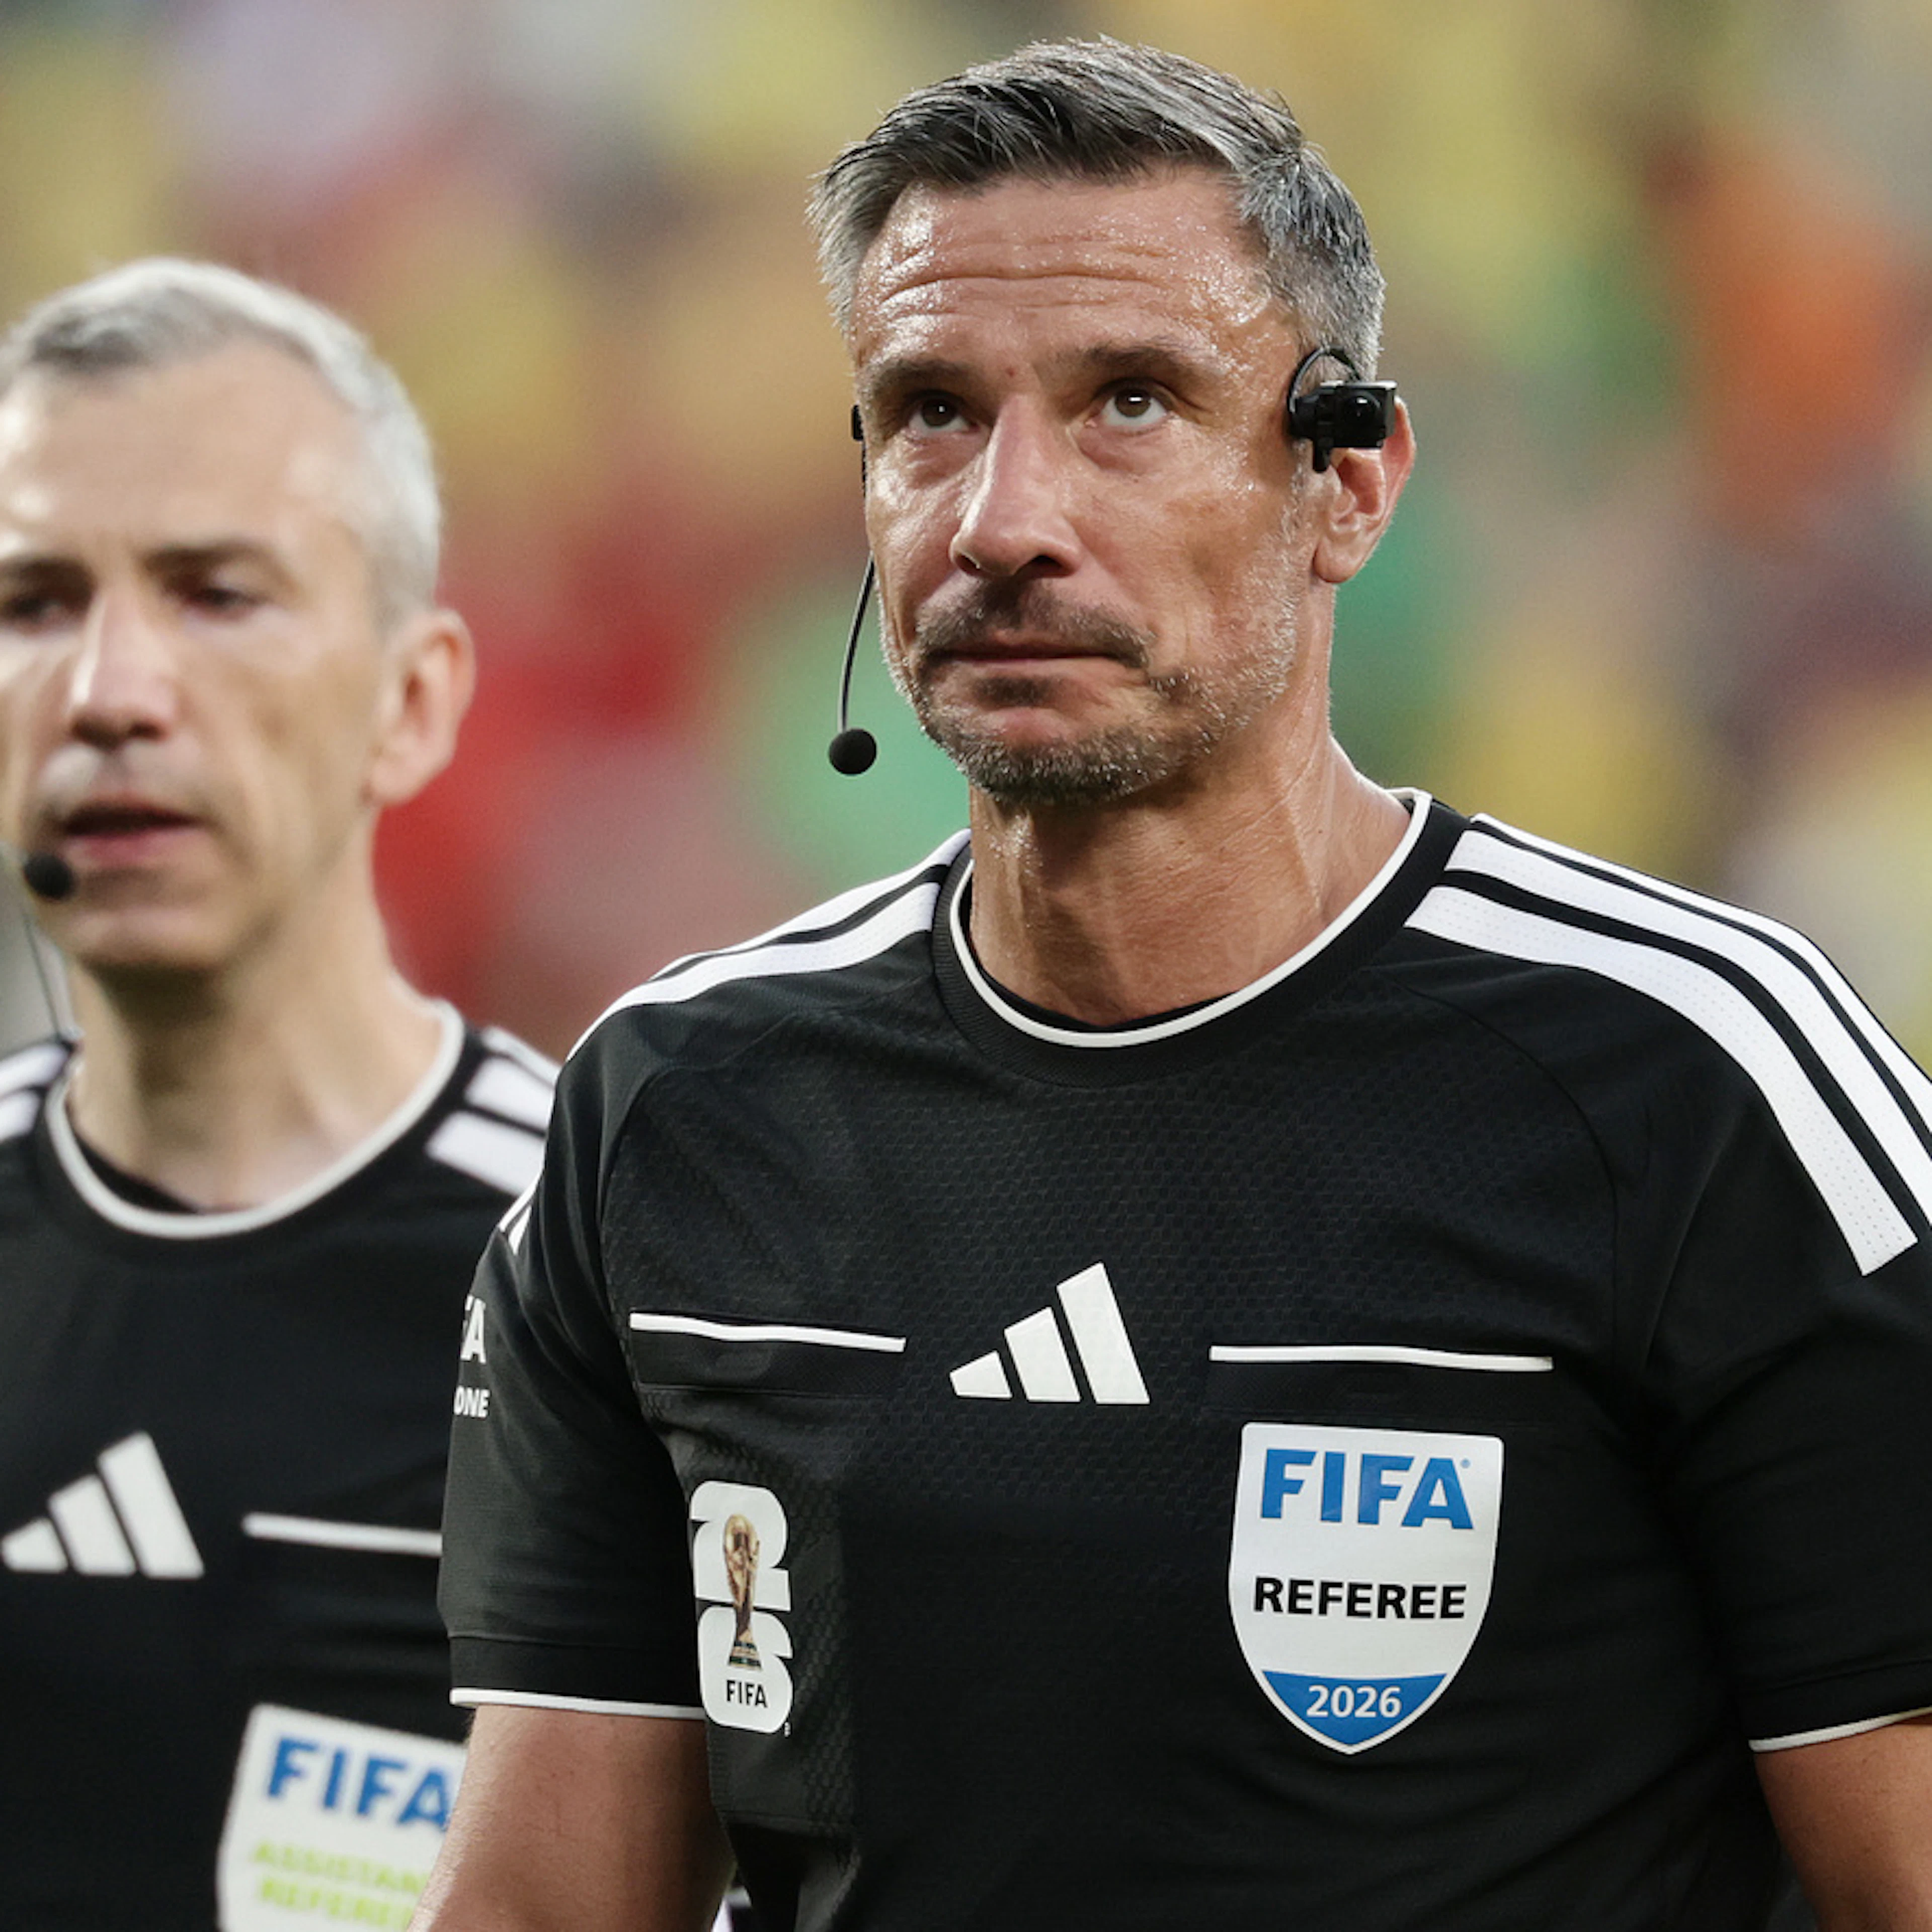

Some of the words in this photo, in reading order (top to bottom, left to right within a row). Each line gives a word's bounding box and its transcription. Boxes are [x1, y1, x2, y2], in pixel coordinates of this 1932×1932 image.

[1260, 1448, 1474, 1530] FIFA
[1253, 1576, 1467, 1620] REFEREE
[726, 1679, 768, 1709] FIFA
[1306, 1684, 1403, 1718] 2026
[267, 1736, 451, 1831] FIFA
[253, 1840, 431, 1897] ASSISTAN
